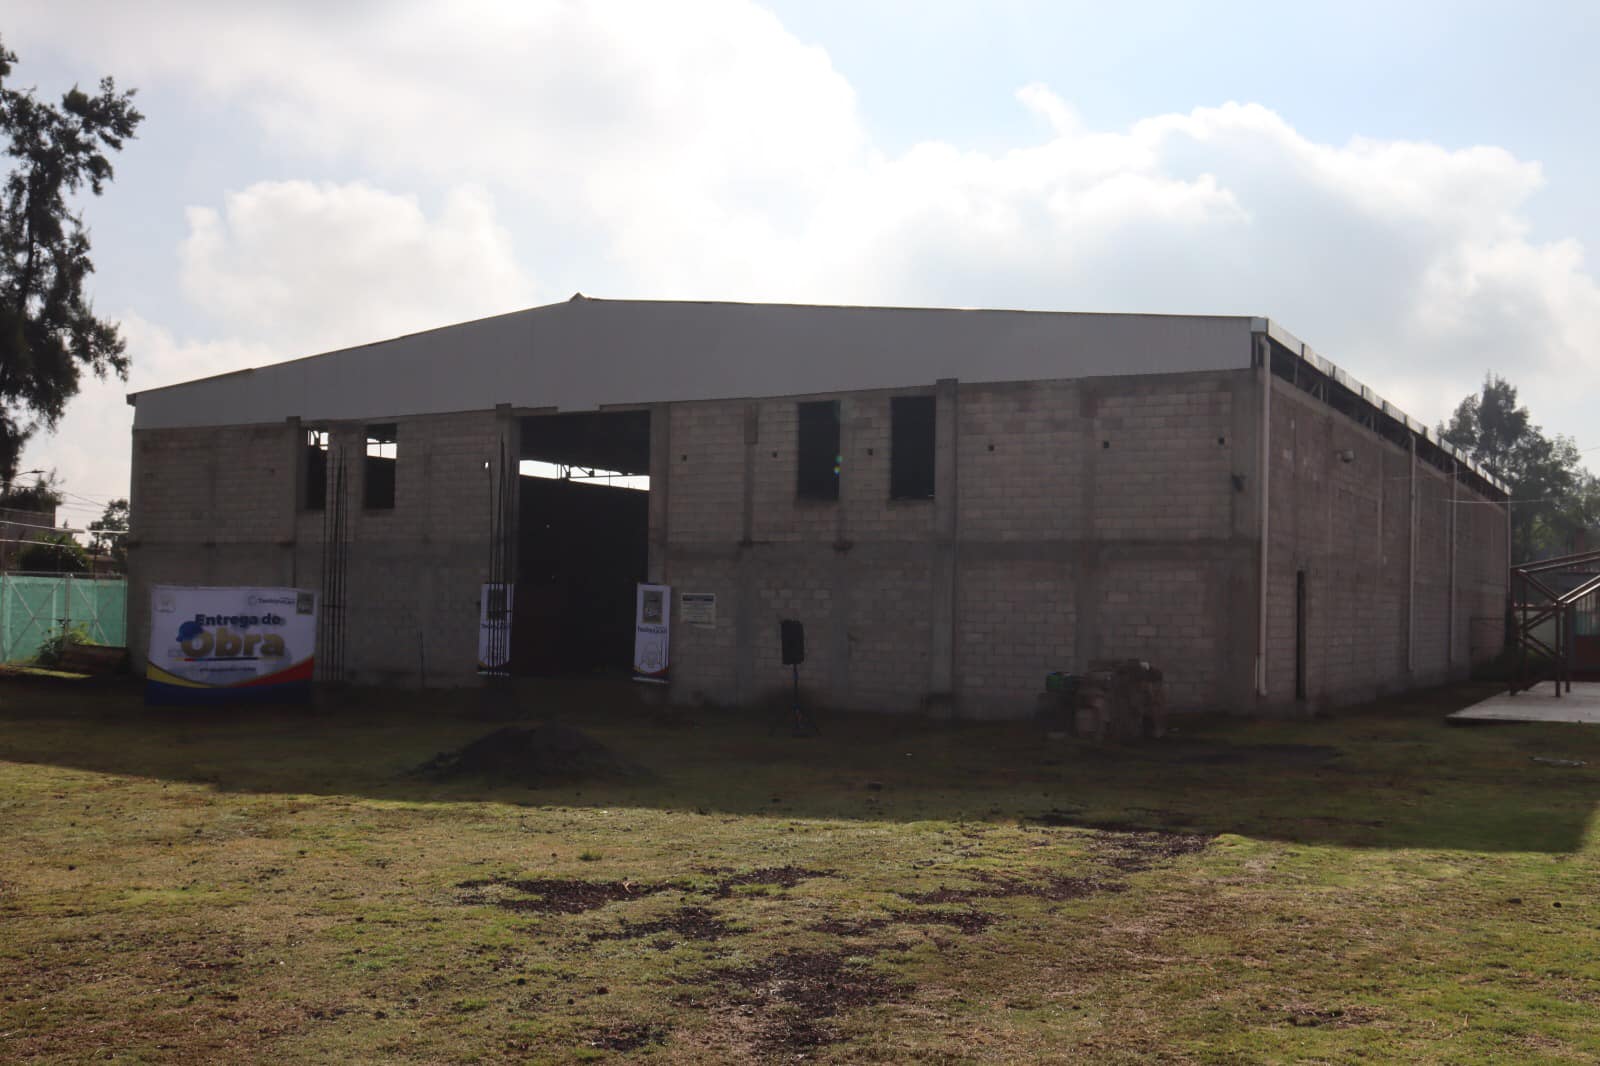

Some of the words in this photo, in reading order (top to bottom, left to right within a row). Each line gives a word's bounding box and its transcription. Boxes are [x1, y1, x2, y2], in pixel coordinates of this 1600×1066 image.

[195, 614, 258, 628] Entrega
[262, 613, 283, 625] de
[181, 627, 285, 657] Obra
